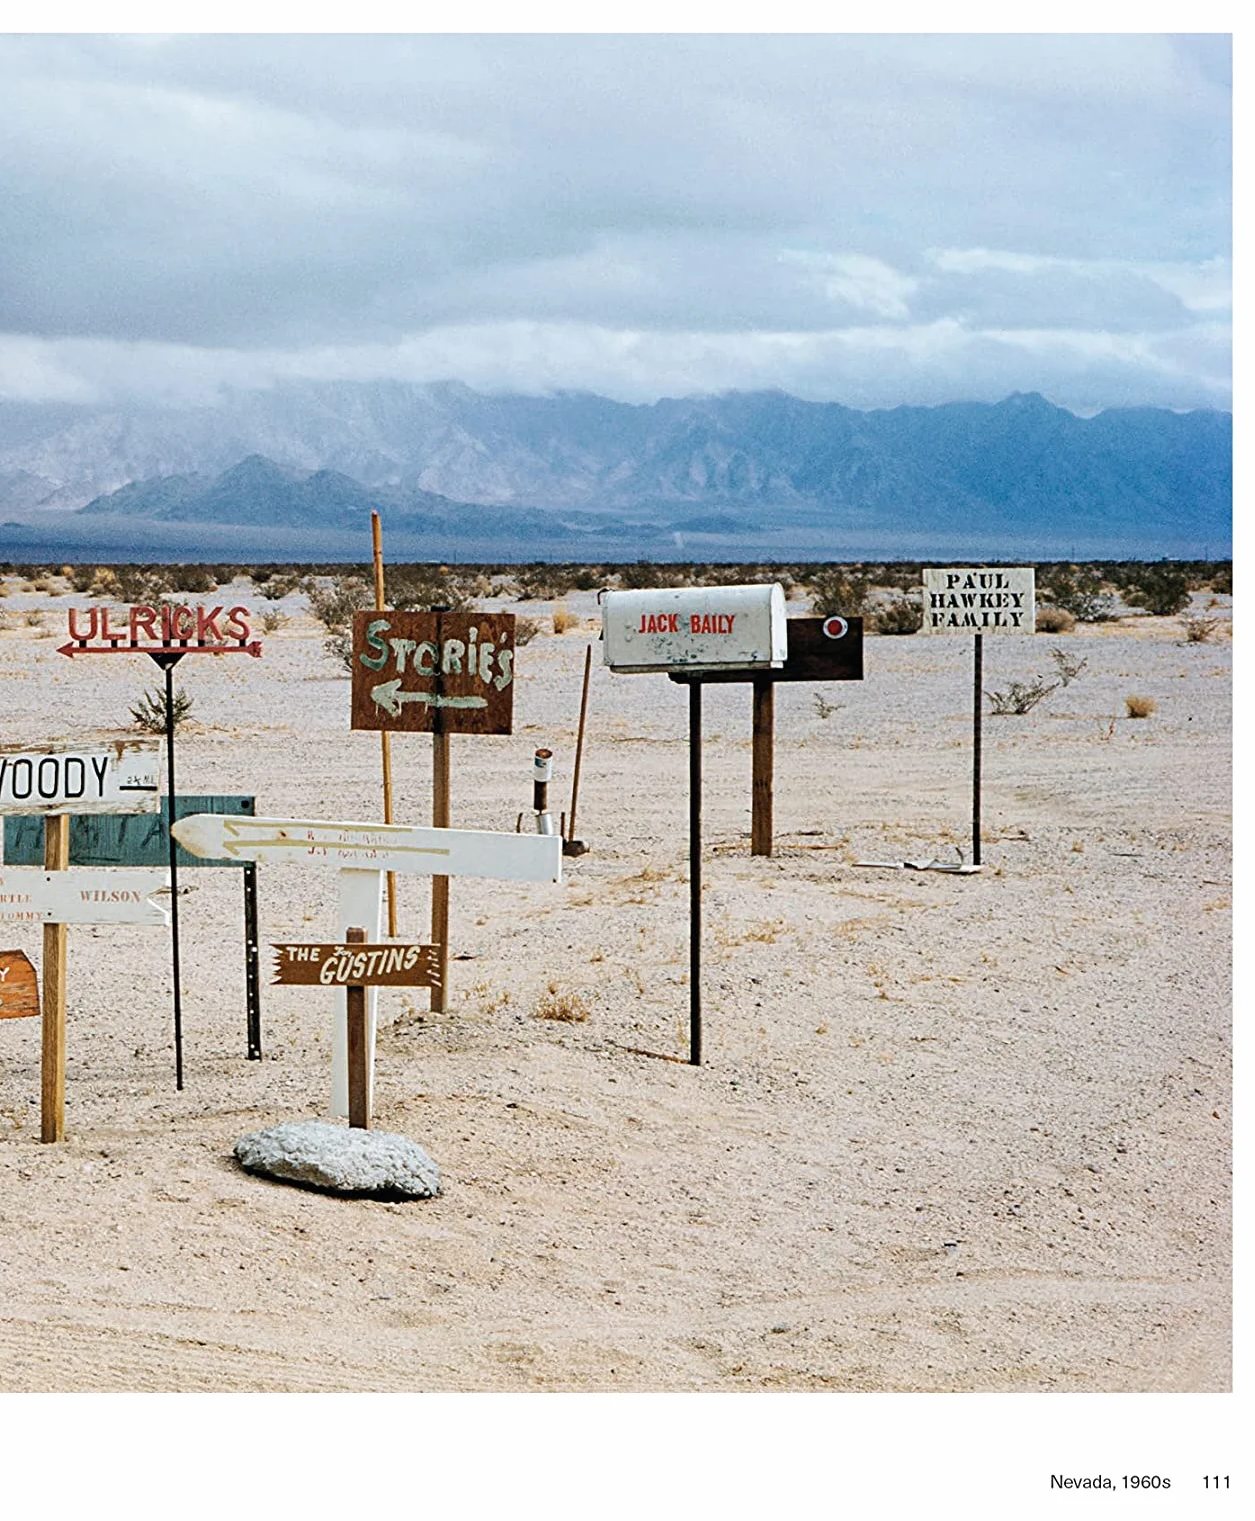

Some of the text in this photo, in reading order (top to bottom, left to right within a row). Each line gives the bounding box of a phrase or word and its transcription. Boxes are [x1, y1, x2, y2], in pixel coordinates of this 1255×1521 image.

[946, 573, 1009, 589] PAUL
[929, 593, 1024, 608] HAWKEY
[68, 605, 252, 641] ULRICKS
[638, 613, 735, 634] JACK BAILY
[932, 612, 1023, 627] FAMILY
[80, 889, 142, 902] WILSON
[286, 946, 322, 962] THE
[319, 946, 421, 985] GUSTINS
